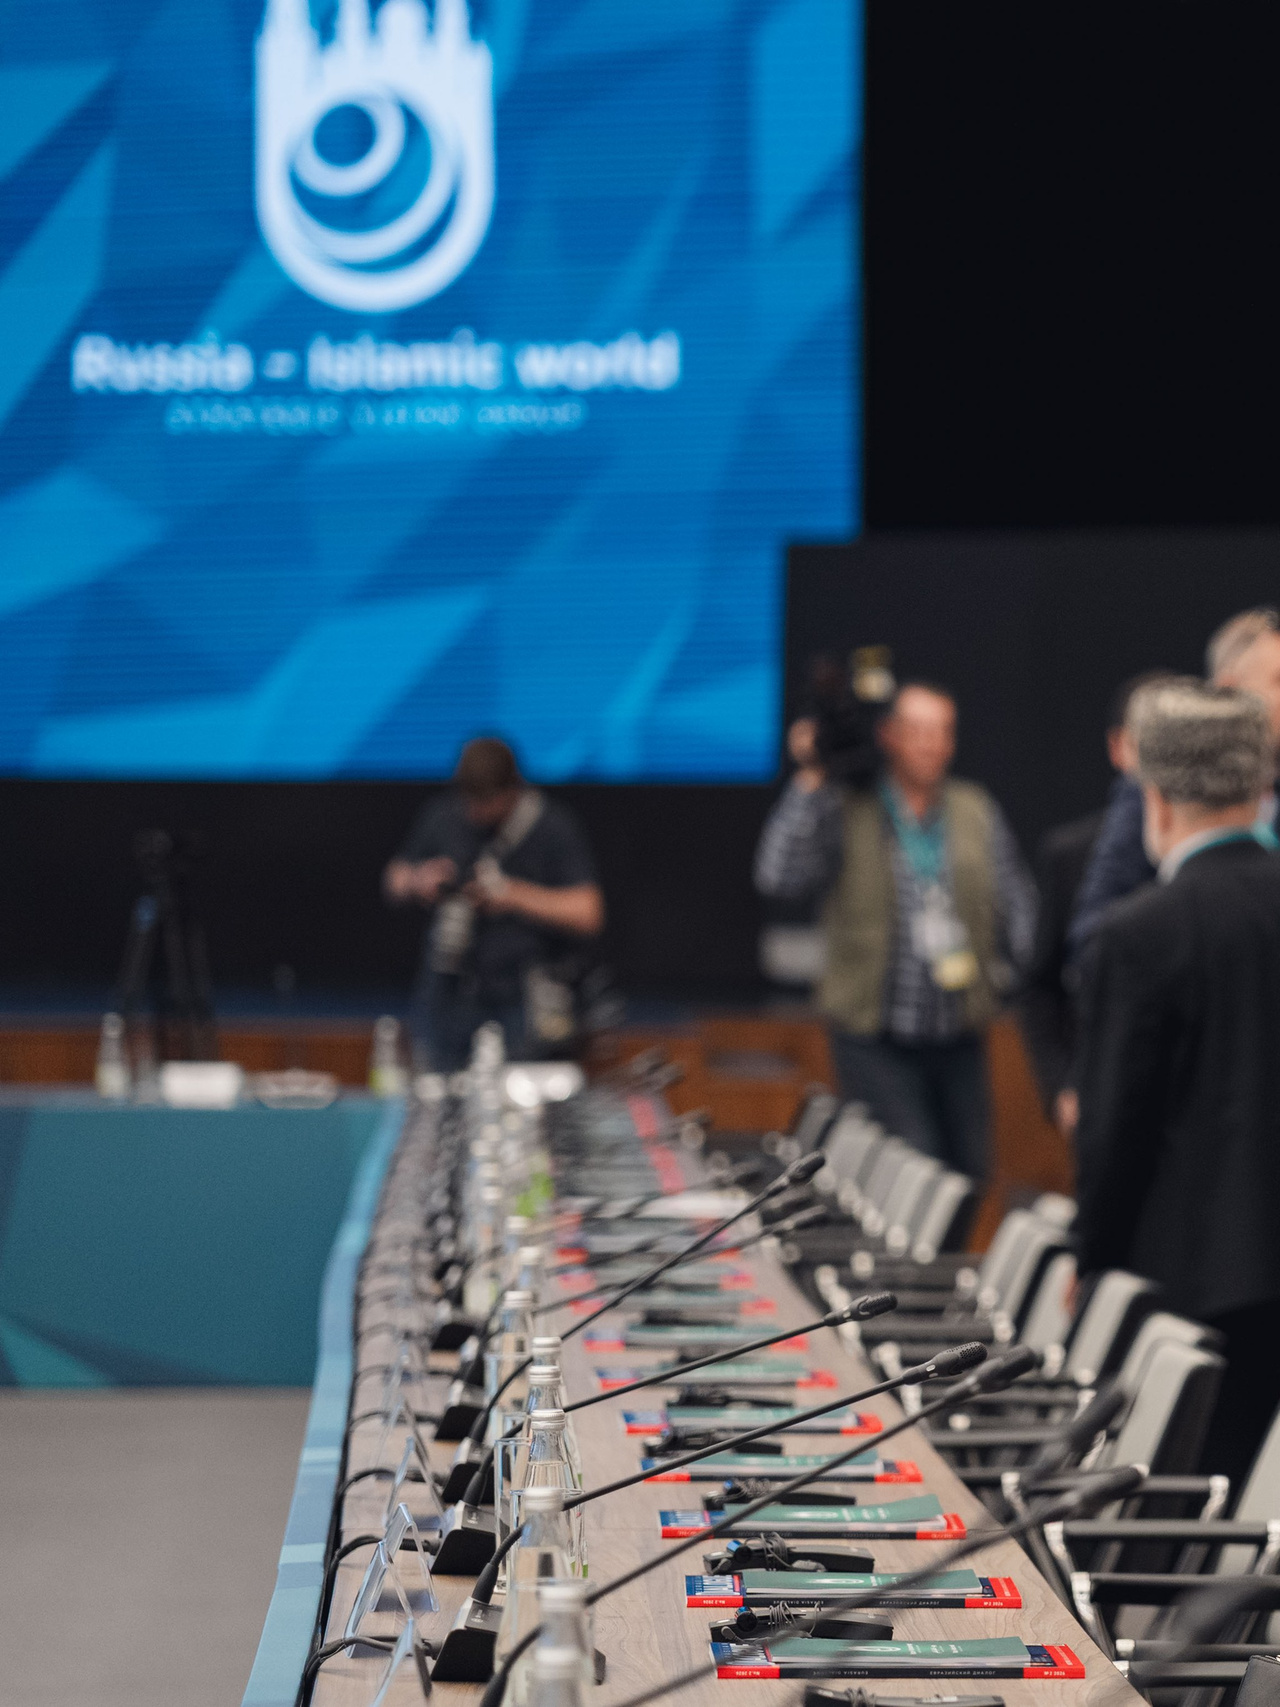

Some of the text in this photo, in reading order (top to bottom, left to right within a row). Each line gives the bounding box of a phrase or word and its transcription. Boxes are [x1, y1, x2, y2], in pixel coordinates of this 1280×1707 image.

[73, 331, 253, 391] Russia
[307, 328, 502, 390] Islamic
[514, 331, 680, 390] world
